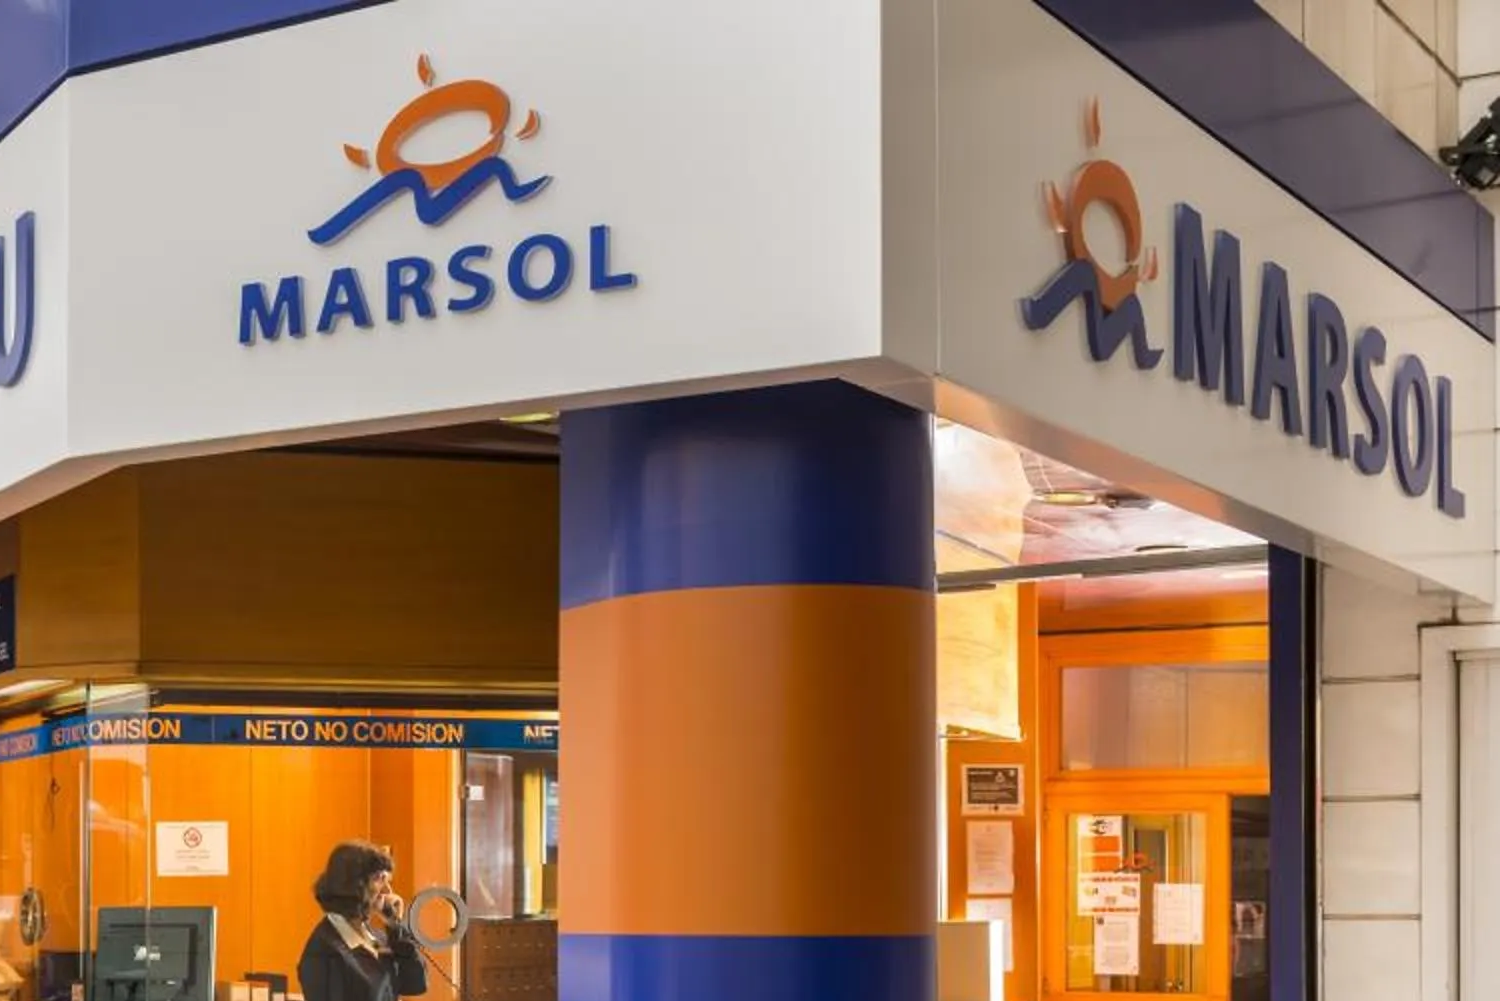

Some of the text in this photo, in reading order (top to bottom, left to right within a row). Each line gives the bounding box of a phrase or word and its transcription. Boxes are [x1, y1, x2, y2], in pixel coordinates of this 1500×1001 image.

[238, 224, 638, 347] MARSOL
[1172, 202, 1466, 520] MARSOL
[245, 719, 463, 744] NETO NO COMISION
